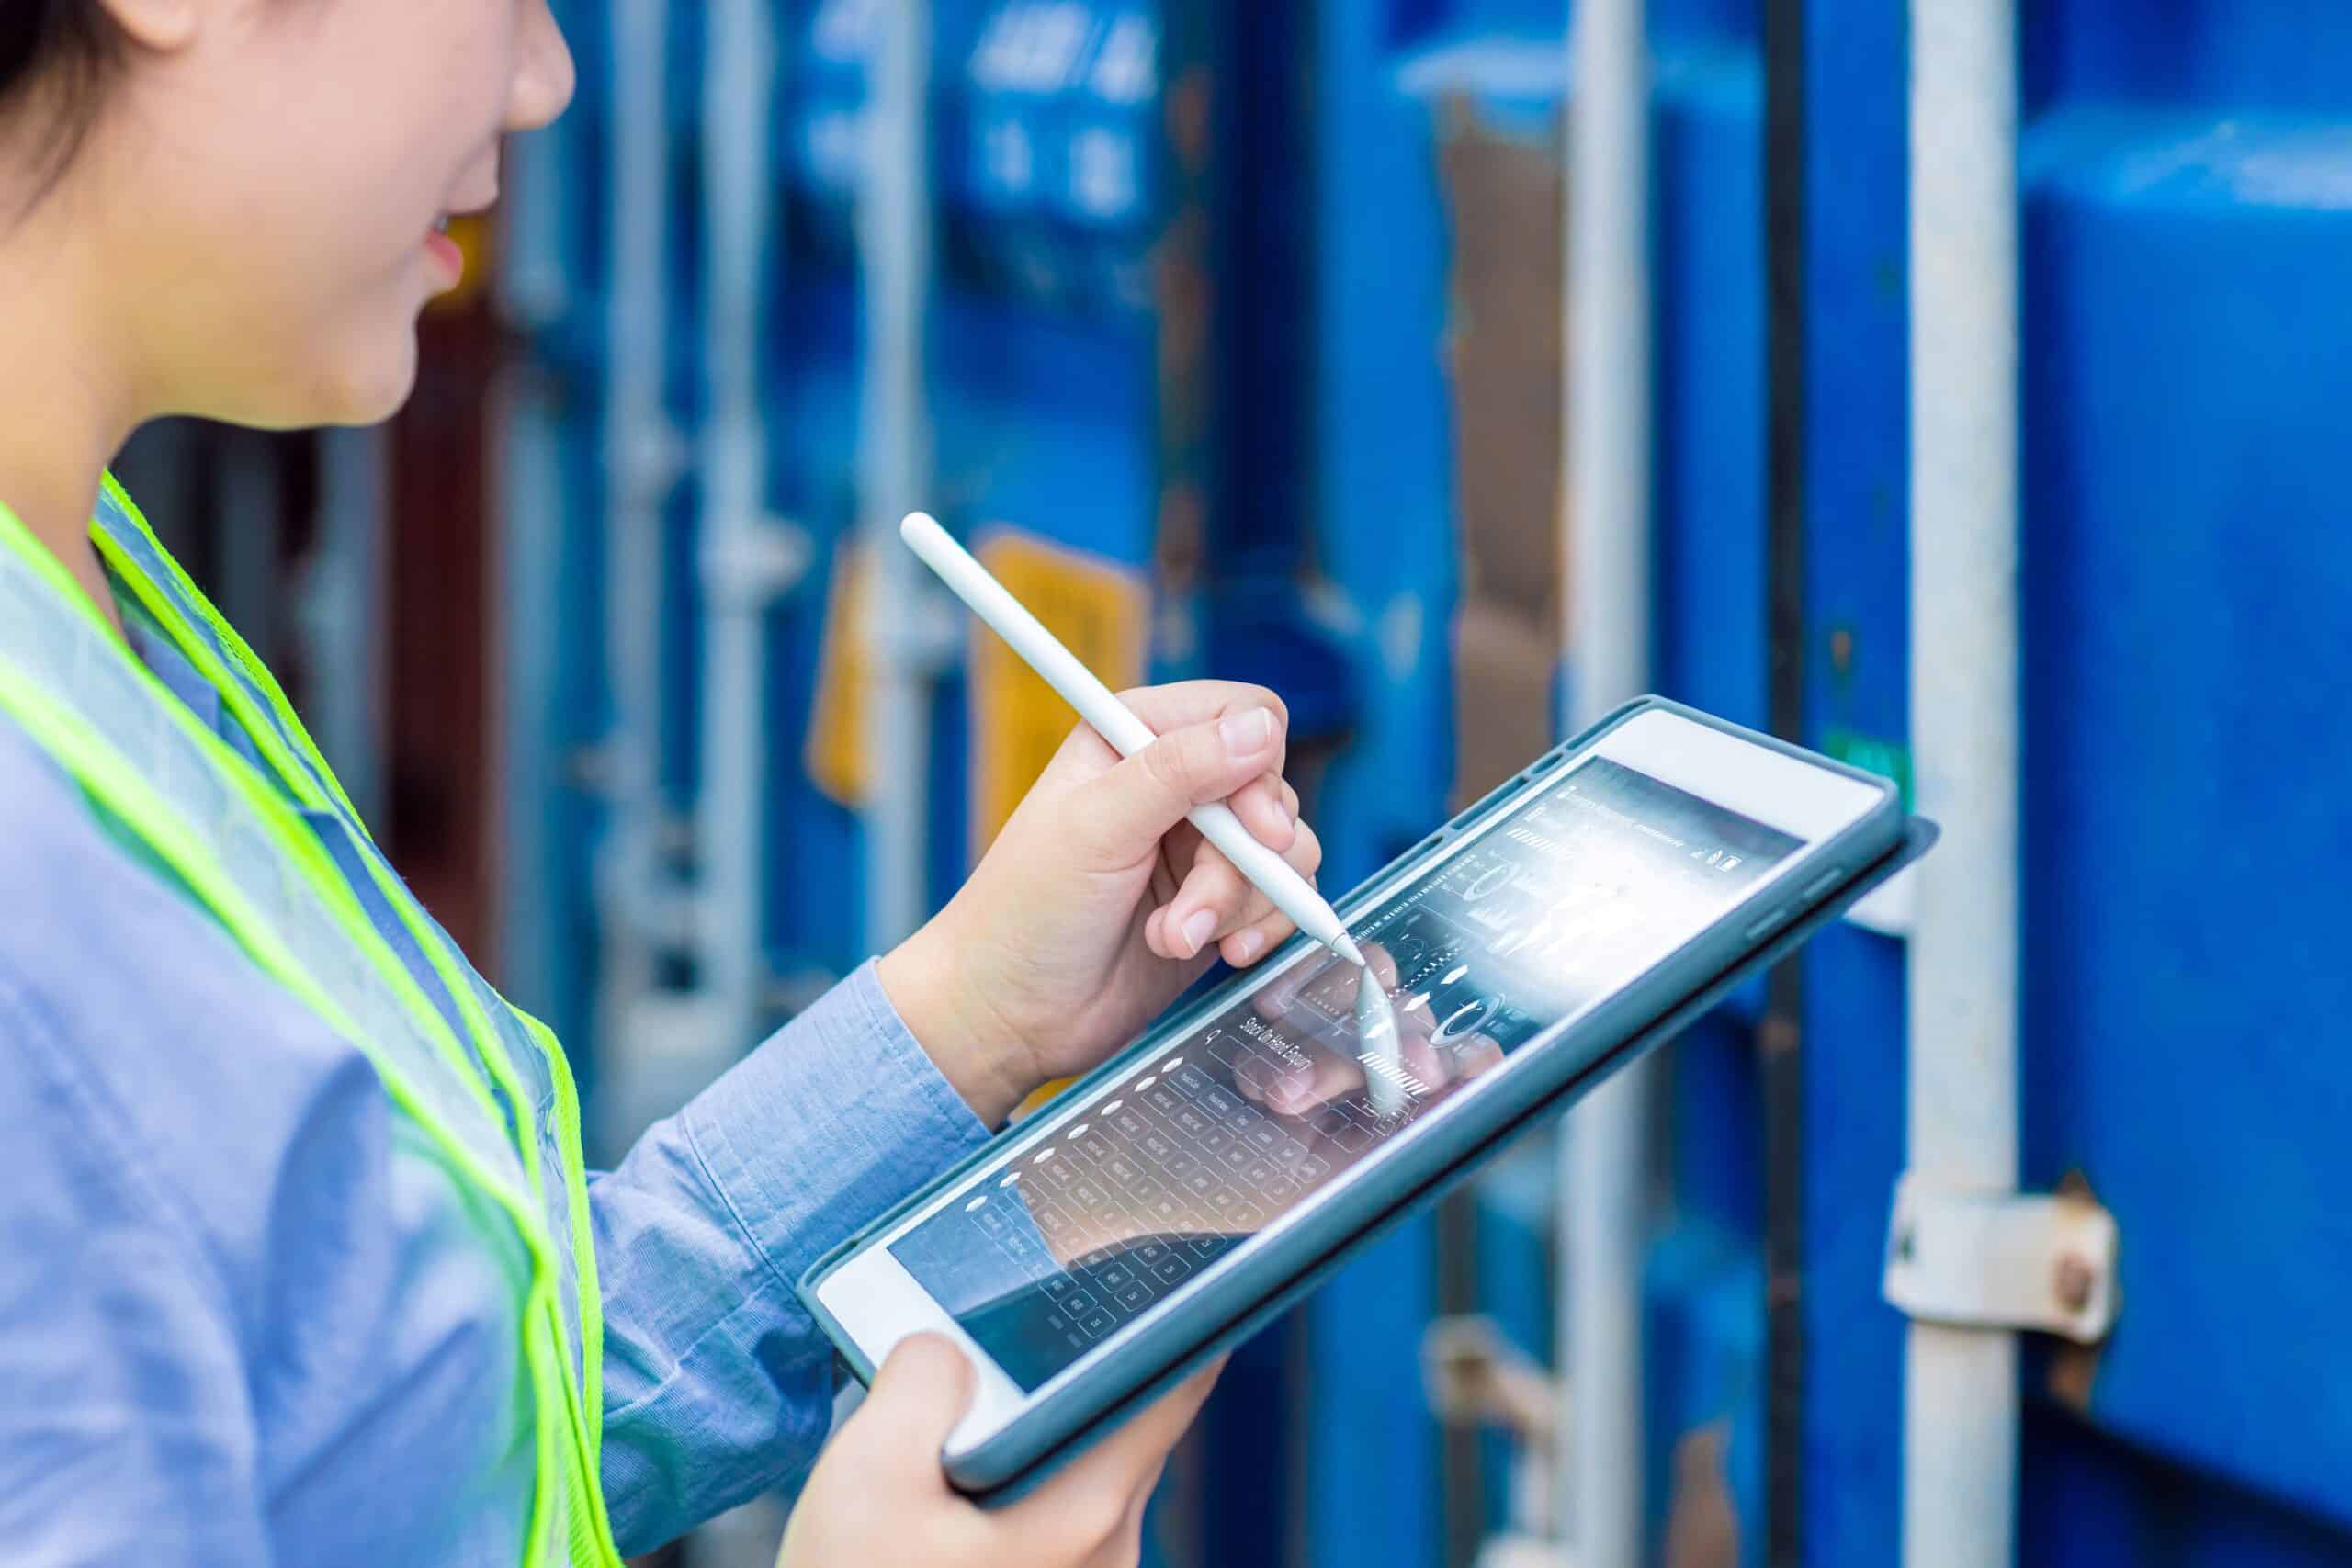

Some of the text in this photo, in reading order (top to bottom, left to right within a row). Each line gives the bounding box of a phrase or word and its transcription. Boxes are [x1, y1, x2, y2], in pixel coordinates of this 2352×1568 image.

[1238, 1016, 1314, 1074] Stock On Hand Enquiry
